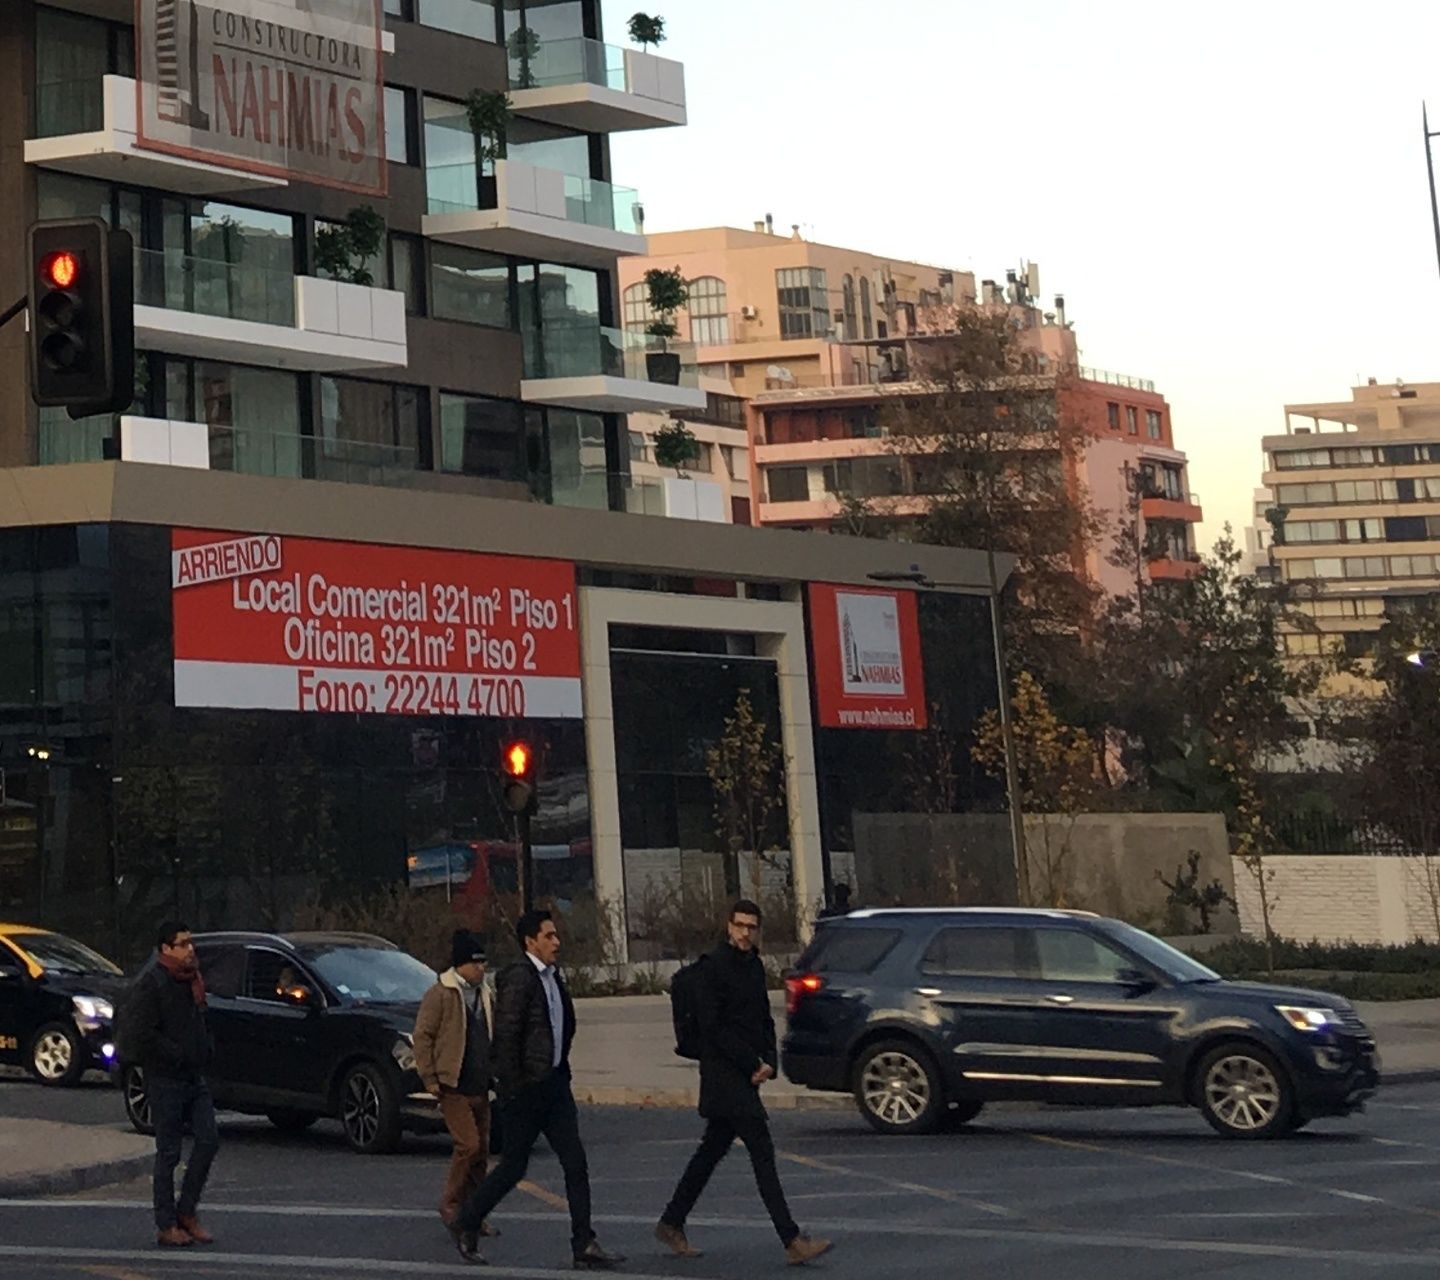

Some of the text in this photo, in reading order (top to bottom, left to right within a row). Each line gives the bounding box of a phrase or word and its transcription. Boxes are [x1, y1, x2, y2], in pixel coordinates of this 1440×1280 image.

[212, 8, 361, 71] CONSTRUCTORA
[212, 52, 367, 164] NAHMIAS
[177, 535, 280, 584] ARRIENDO
[233, 572, 302, 614] Local
[307, 573, 428, 622] Comercial
[509, 587, 558, 630] Piso
[562, 593, 573, 630] 1
[284, 616, 376, 664] Oficina
[465, 627, 517, 670] Piso
[522, 631, 537, 670] 2
[298, 669, 526, 719] Fono: 22244 4700
[861, 663, 902, 685] NAHMIAS
